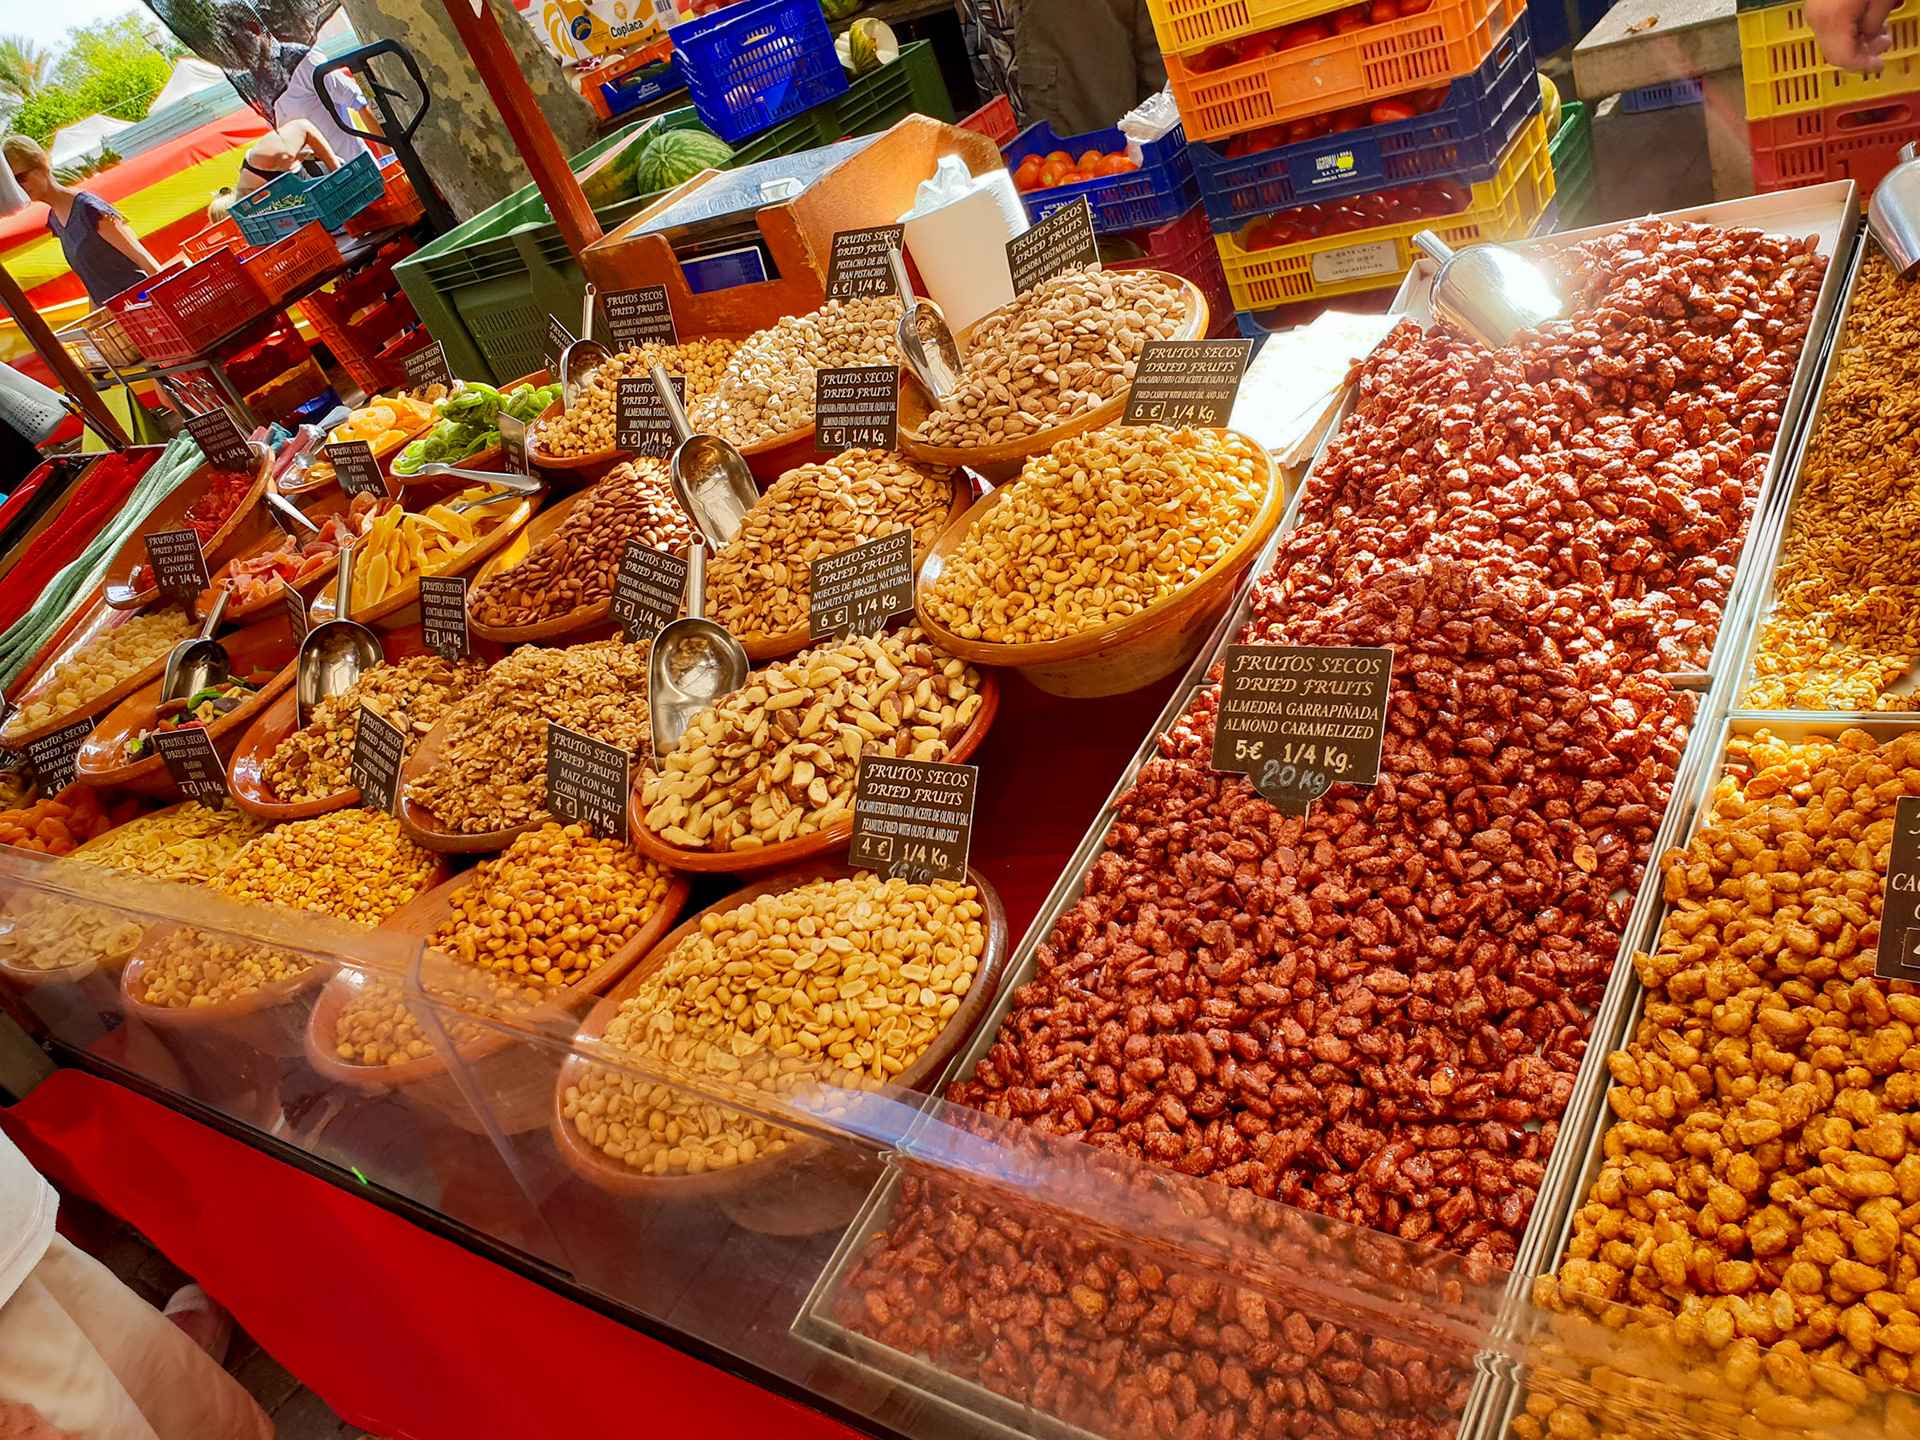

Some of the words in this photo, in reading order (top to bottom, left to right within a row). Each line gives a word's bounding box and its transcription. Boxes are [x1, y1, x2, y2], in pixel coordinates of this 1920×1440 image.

[610, 18, 644, 39] Coplaca
[835, 232, 873, 248] FRUTOS
[873, 229, 901, 241] SECOS
[1011, 223, 1051, 257] FRUTOS
[1052, 203, 1082, 229] SECOS
[1015, 239, 1046, 265] DRIED
[1048, 217, 1082, 246] FRUITS
[1013, 257, 1042, 280] ALMENDRA
[1042, 243, 1067, 262] TOSTADA
[1066, 232, 1080, 247] CON
[1079, 227, 1091, 239] SAL
[1336, 246, 1382, 258] ESTELRICH
[838, 271, 853, 281] IRAN
[853, 267, 887, 279] PISTACHIO
[1017, 271, 1037, 289] BROWN
[1038, 257, 1061, 277] ALMOND
[1061, 246, 1076, 262] WITH
[1076, 239, 1090, 253] SALT
[832, 283, 839, 295] 6
[842, 282, 850, 293] €
[858, 279, 873, 292] 1/4
[875, 278, 889, 293] Kg.
[606, 293, 638, 308] FRUTOS
[639, 290, 663, 302] SECOS
[610, 306, 635, 317] DRIED
[636, 302, 664, 315] FRUITS
[404, 352, 425, 370] FRUTOS
[424, 346, 440, 359] SECOS
[1145, 346, 1201, 360] FRUTOS
[1202, 346, 1244, 358] SECOS
[408, 364, 425, 376] DRIED
[424, 356, 442, 371] FRUITS
[1145, 362, 1187, 373] DRIED
[1187, 361, 1237, 374] FRUITS
[620, 383, 655, 395] FRUTOS
[821, 373, 862, 387] FRUTOS
[864, 371, 894, 384] SECOS
[622, 396, 649, 406] DRIED
[823, 387, 854, 399] DRIED
[855, 386, 891, 399] FRUITS
[1135, 404, 1143, 418] 6
[1150, 405, 1160, 417] €
[1172, 404, 1194, 419] 1/4
[1198, 405, 1217, 423] Kg.
[629, 420, 648, 429] BROWN
[648, 420, 672, 429] ALMOND
[621, 433, 627, 445] 6
[630, 433, 637, 445] €
[645, 432, 660, 445] 1/4
[662, 432, 675, 448] Kg.
[823, 430, 829, 444] 6
[834, 430, 842, 443] €
[853, 429, 869, 442] 1/4
[872, 429, 887, 446] Kg.
[329, 446, 352, 458] FRUTOS
[351, 445, 369, 454] SECOS
[333, 456, 352, 465] DRIED
[351, 454, 371, 465] FRUITS
[148, 534, 175, 547] FRUTOS
[175, 532, 194, 543] SECOS
[151, 546, 173, 555] DRIED
[173, 543, 196, 554] FRUITS
[158, 553, 195, 565] JENJIBRE
[625, 546, 660, 567] FRUTOS
[660, 559, 687, 577] SECOS
[815, 549, 867, 577] FRUTOS
[869, 535, 906, 557] SECOS
[163, 563, 195, 574] GINGER
[625, 561, 651, 577] DRIED
[649, 570, 681, 589] FRUITS
[819, 566, 857, 586] DRIED
[859, 550, 904, 575] FRUITS
[421, 581, 445, 592] FRUTOS
[445, 583, 463, 594] SECOS
[813, 585, 841, 601] NUECES
[841, 582, 852, 592] DE
[852, 573, 876, 589] BRASIL
[876, 562, 909, 580] NATURAL
[423, 594, 442, 604] DRIED
[441, 596, 462, 606] FRUITS
[619, 586, 643, 602] CALIFORNIA
[643, 595, 661, 610] NATURAL
[661, 602, 673, 615] NUTS
[810, 596, 842, 613] WALNUTS
[843, 592, 854, 602] OF
[854, 584, 879, 599] BRAZIL
[879, 573, 912, 591] NATURAL
[821, 614, 829, 628] 6
[834, 610, 844, 623] €
[857, 598, 878, 616] 1/4
[882, 594, 901, 610] Kg.
[425, 631, 431, 643] 6
[431, 633, 437, 644] €
[442, 631, 453, 644] 1/4
[1232, 654, 1316, 673] FRUTOS
[1318, 657, 1382, 675] SECOS
[1235, 676, 1297, 692] DRIED
[1299, 678, 1374, 697] FRUITS
[1223, 699, 1282, 715] ALMEDRA
[1286, 701, 1379, 721] GARRAPIÑADA
[361, 712, 385, 737] FRUTOS
[384, 729, 403, 750] SECOS
[1223, 717, 1278, 734] ALMOND
[1280, 721, 1374, 740] CARAMELIZED
[28, 733, 63, 757] FRUTOS
[64, 722, 90, 740] SECOS
[159, 736, 186, 750] FRUTOS
[185, 733, 206, 745] SECOS
[360, 726, 379, 746] DRIED
[377, 740, 399, 762] FRUITS
[552, 732, 592, 756] FRUTOS
[593, 748, 624, 768] SECOS
[165, 749, 187, 760] DRIED
[186, 746, 210, 758] FRUITS
[1283, 742, 1316, 765] 1/4
[1323, 745, 1353, 774] Kg.
[554, 748, 585, 768] DRIED
[585, 761, 621, 783] FRUITS
[865, 763, 924, 782] FRUTOS
[925, 769, 969, 788] SECOS
[1260, 759, 1296, 788] 20
[47, 786, 54, 796] 4
[56, 782, 63, 792] €
[560, 767, 581, 783] MAIZ
[581, 776, 600, 791] CON
[600, 783, 617, 798] SAL
[555, 780, 578, 796] CORN
[579, 788, 601, 807] WITH
[601, 797, 622, 815] SALT
[867, 782, 911, 799] DRIED
[911, 788, 964, 806] FRUITS
[555, 796, 562, 810] 4
[566, 801, 573, 814] €
[583, 805, 600, 824] 1/4
[603, 812, 618, 834] Kg.
[861, 817, 884, 832] PEANUTS
[883, 821, 899, 834] FRIED
[898, 823, 912, 836] WITH
[911, 824, 926, 839] OLIVE
[925, 826, 935, 840] OIL
[934, 828, 947, 842] AND
[946, 829, 960, 843] SALT
[861, 837, 870, 855] 4
[877, 840, 888, 857] €
[904, 843, 926, 862] 1/4
[931, 847, 951, 872] Kg.
